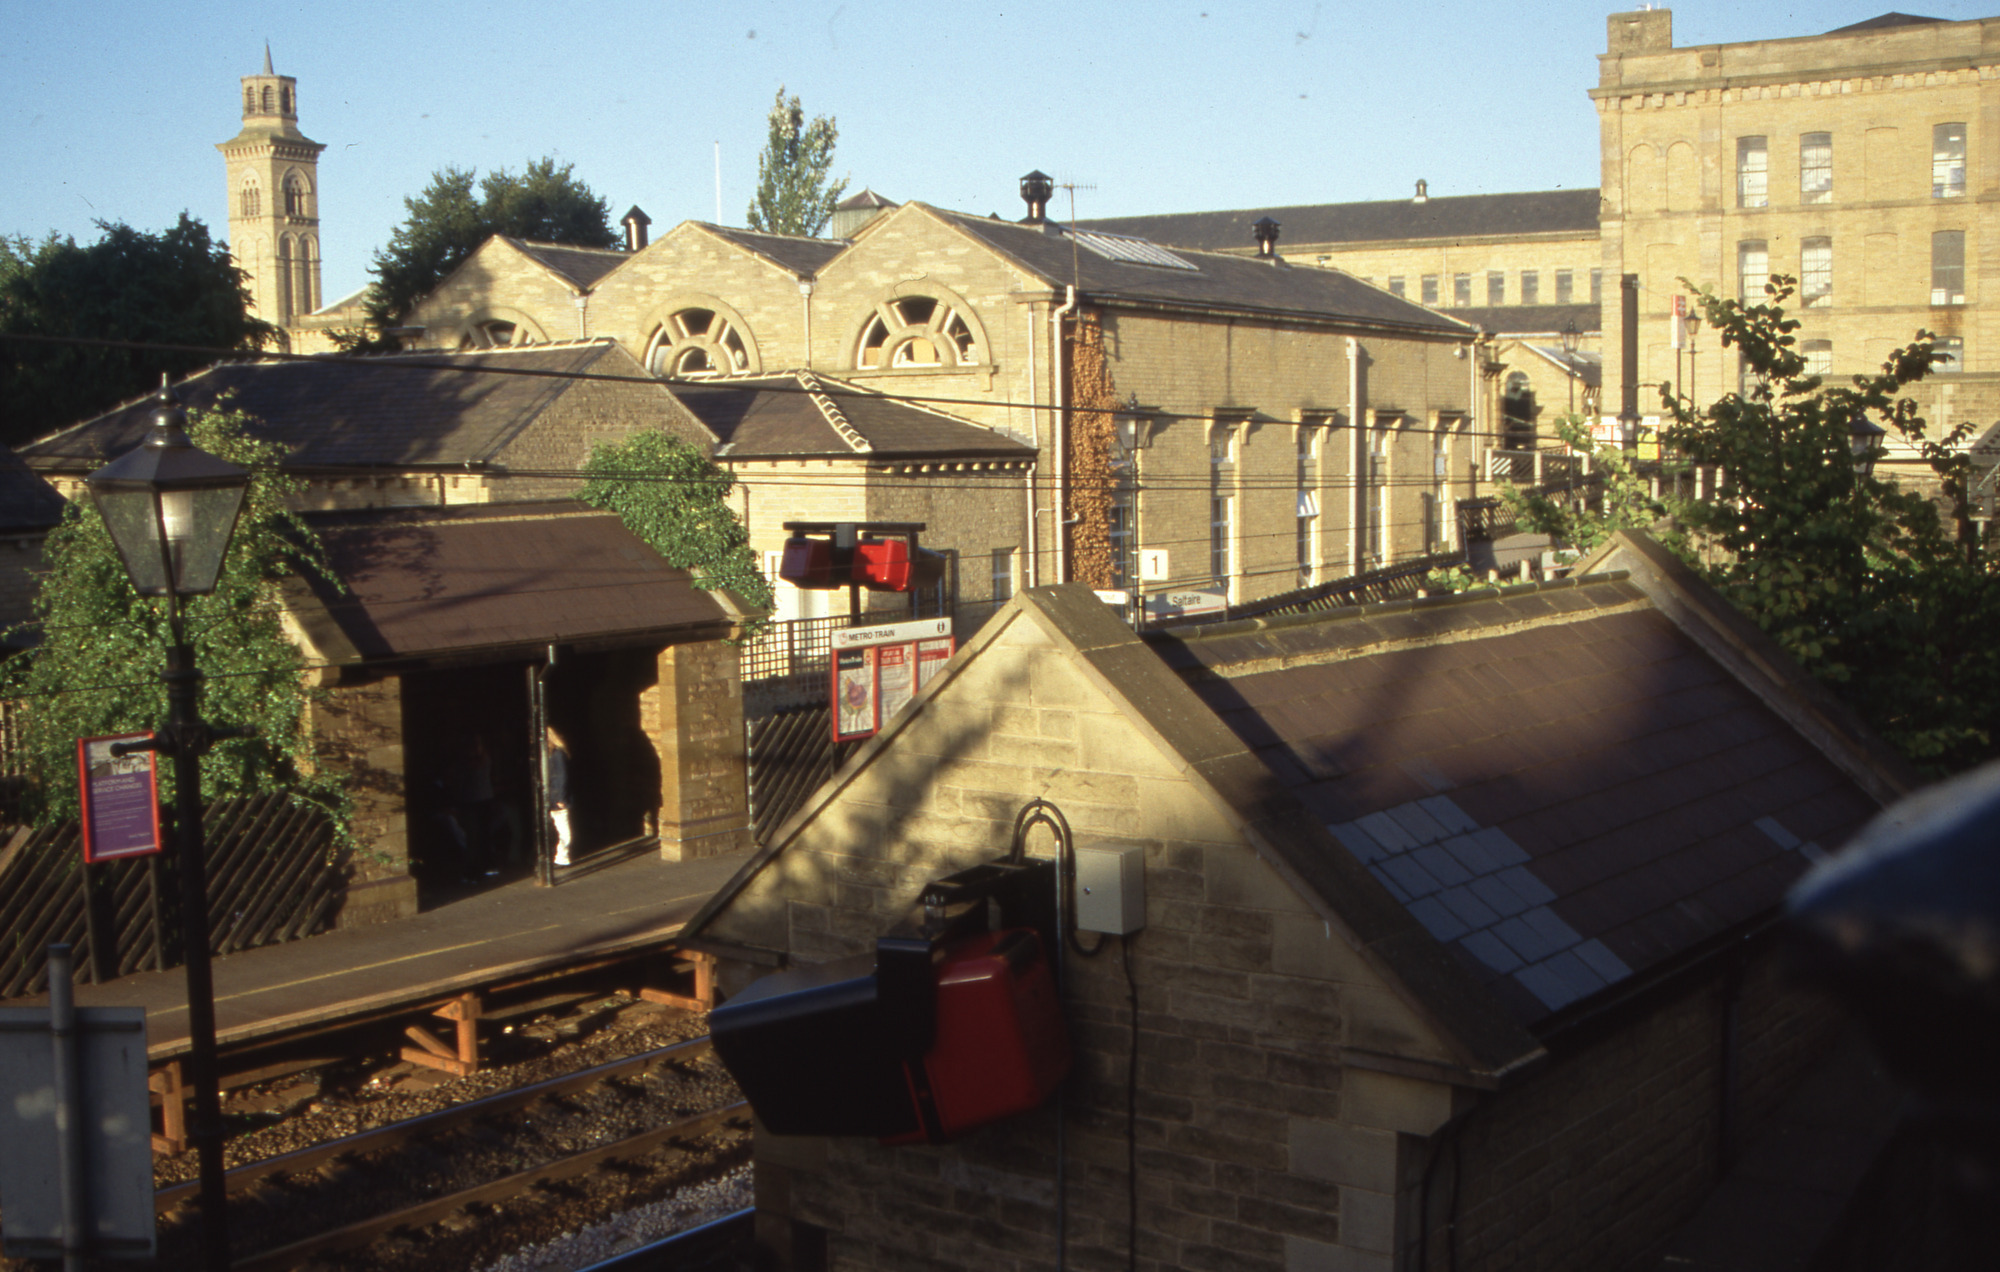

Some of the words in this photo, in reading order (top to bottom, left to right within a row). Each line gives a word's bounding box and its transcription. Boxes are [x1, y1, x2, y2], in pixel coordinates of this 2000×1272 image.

[1151, 555, 1158, 575] 1
[1172, 594, 1201, 607] Saltaire
[874, 629, 895, 639] TRAIN
